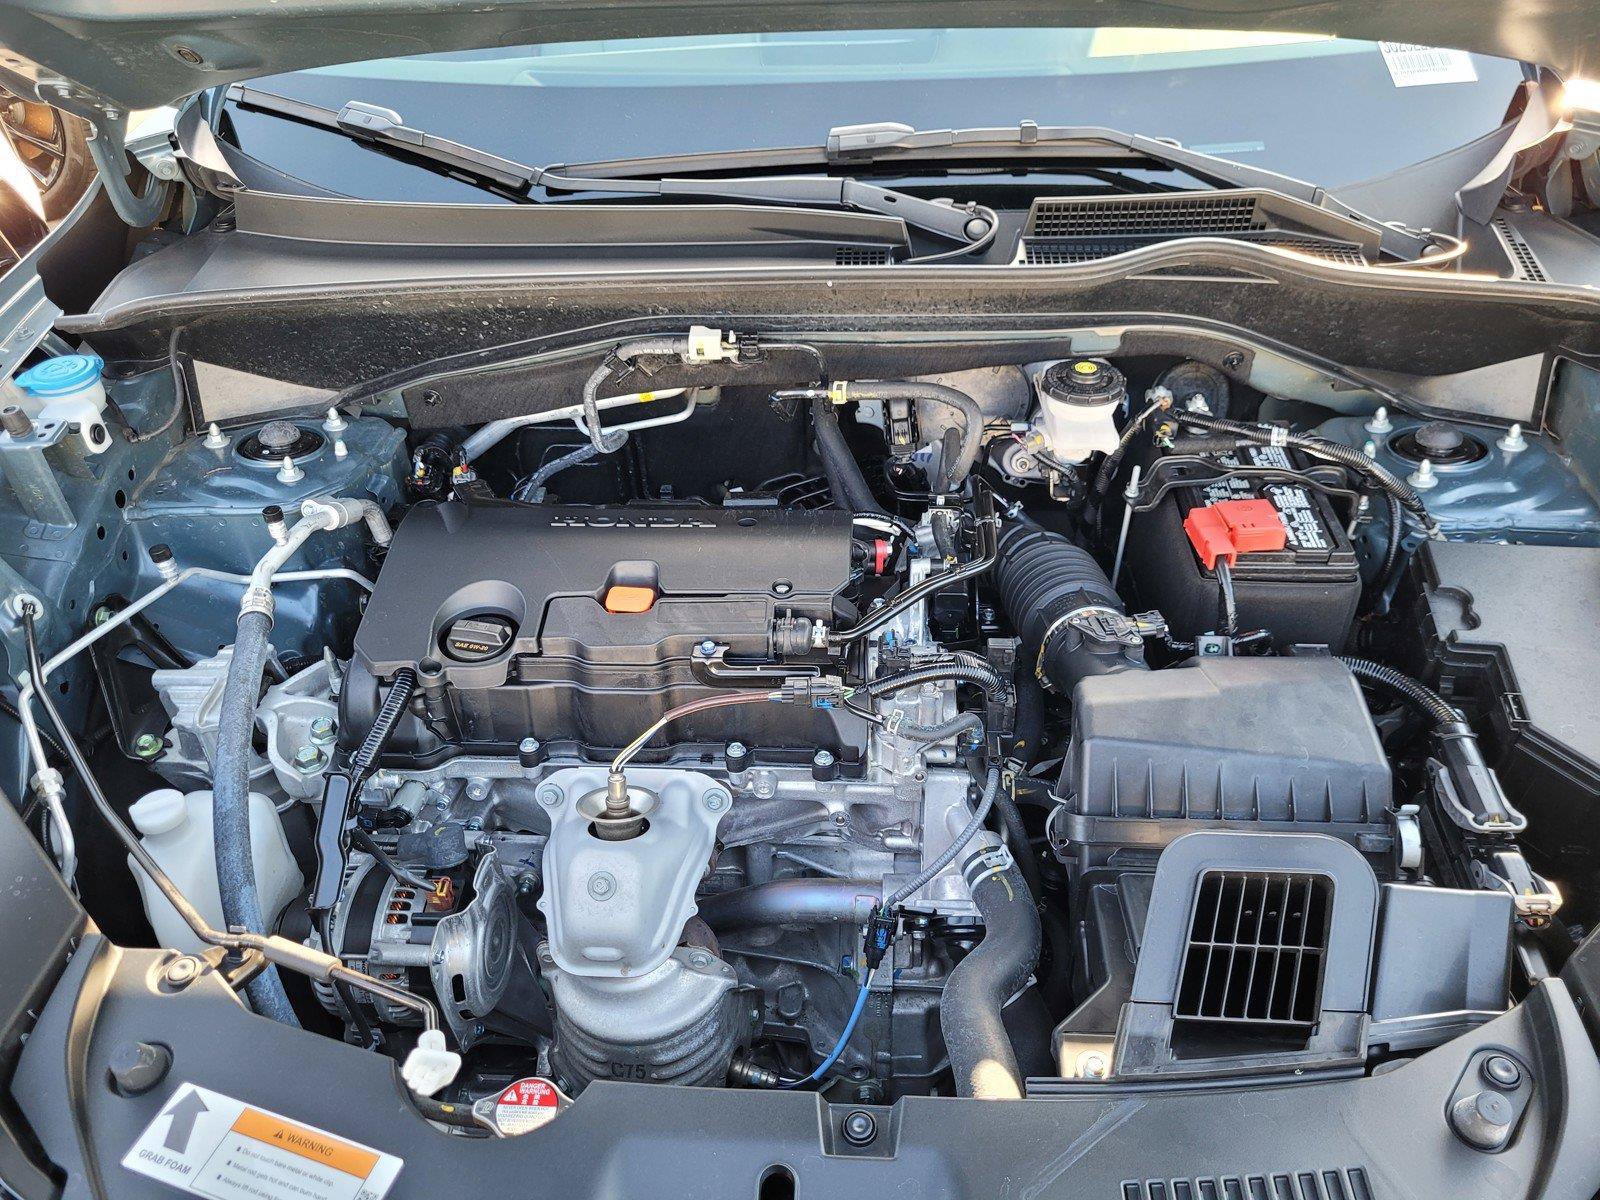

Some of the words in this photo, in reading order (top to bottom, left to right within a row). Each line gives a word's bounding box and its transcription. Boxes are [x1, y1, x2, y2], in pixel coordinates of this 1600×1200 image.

[549, 516, 718, 528] HONDA
[455, 641, 469, 649] SAE
[519, 1087, 550, 1096] WARNING
[520, 1082, 546, 1090] DANGER
[287, 1131, 334, 1156] WARNING
[139, 1149, 165, 1164] GRAB
[164, 1159, 191, 1175] FOAM
[232, 1161, 247, 1171] Metal
[258, 1153, 275, 1164] touch
[287, 1165, 303, 1175] metal
[309, 1173, 323, 1182] white
[223, 1177, 241, 1189] Always
